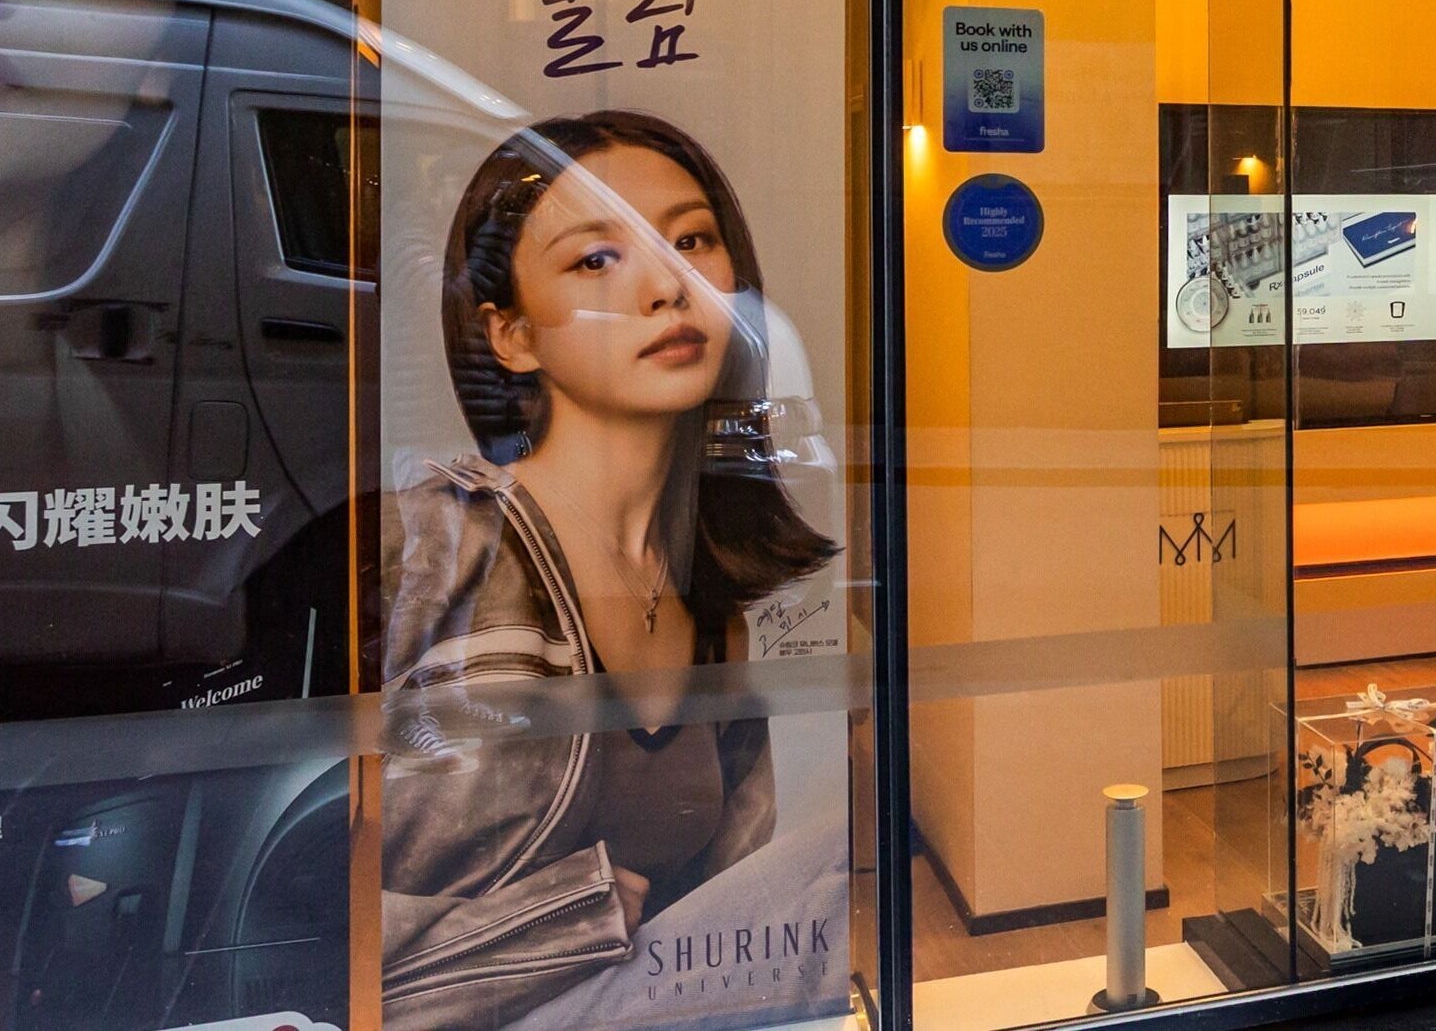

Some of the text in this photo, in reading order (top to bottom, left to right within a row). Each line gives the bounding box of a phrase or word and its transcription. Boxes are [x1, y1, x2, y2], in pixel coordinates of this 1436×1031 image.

[955, 22, 1032, 38] Book with
[960, 39, 1028, 53] us online
[981, 226, 1008, 238] 2025
[1293, 264, 1325, 283] psule
[180, 674, 264, 709] Welcome
[647, 918, 830, 976] SHURINK
[647, 960, 829, 1002] UNIVERSE
